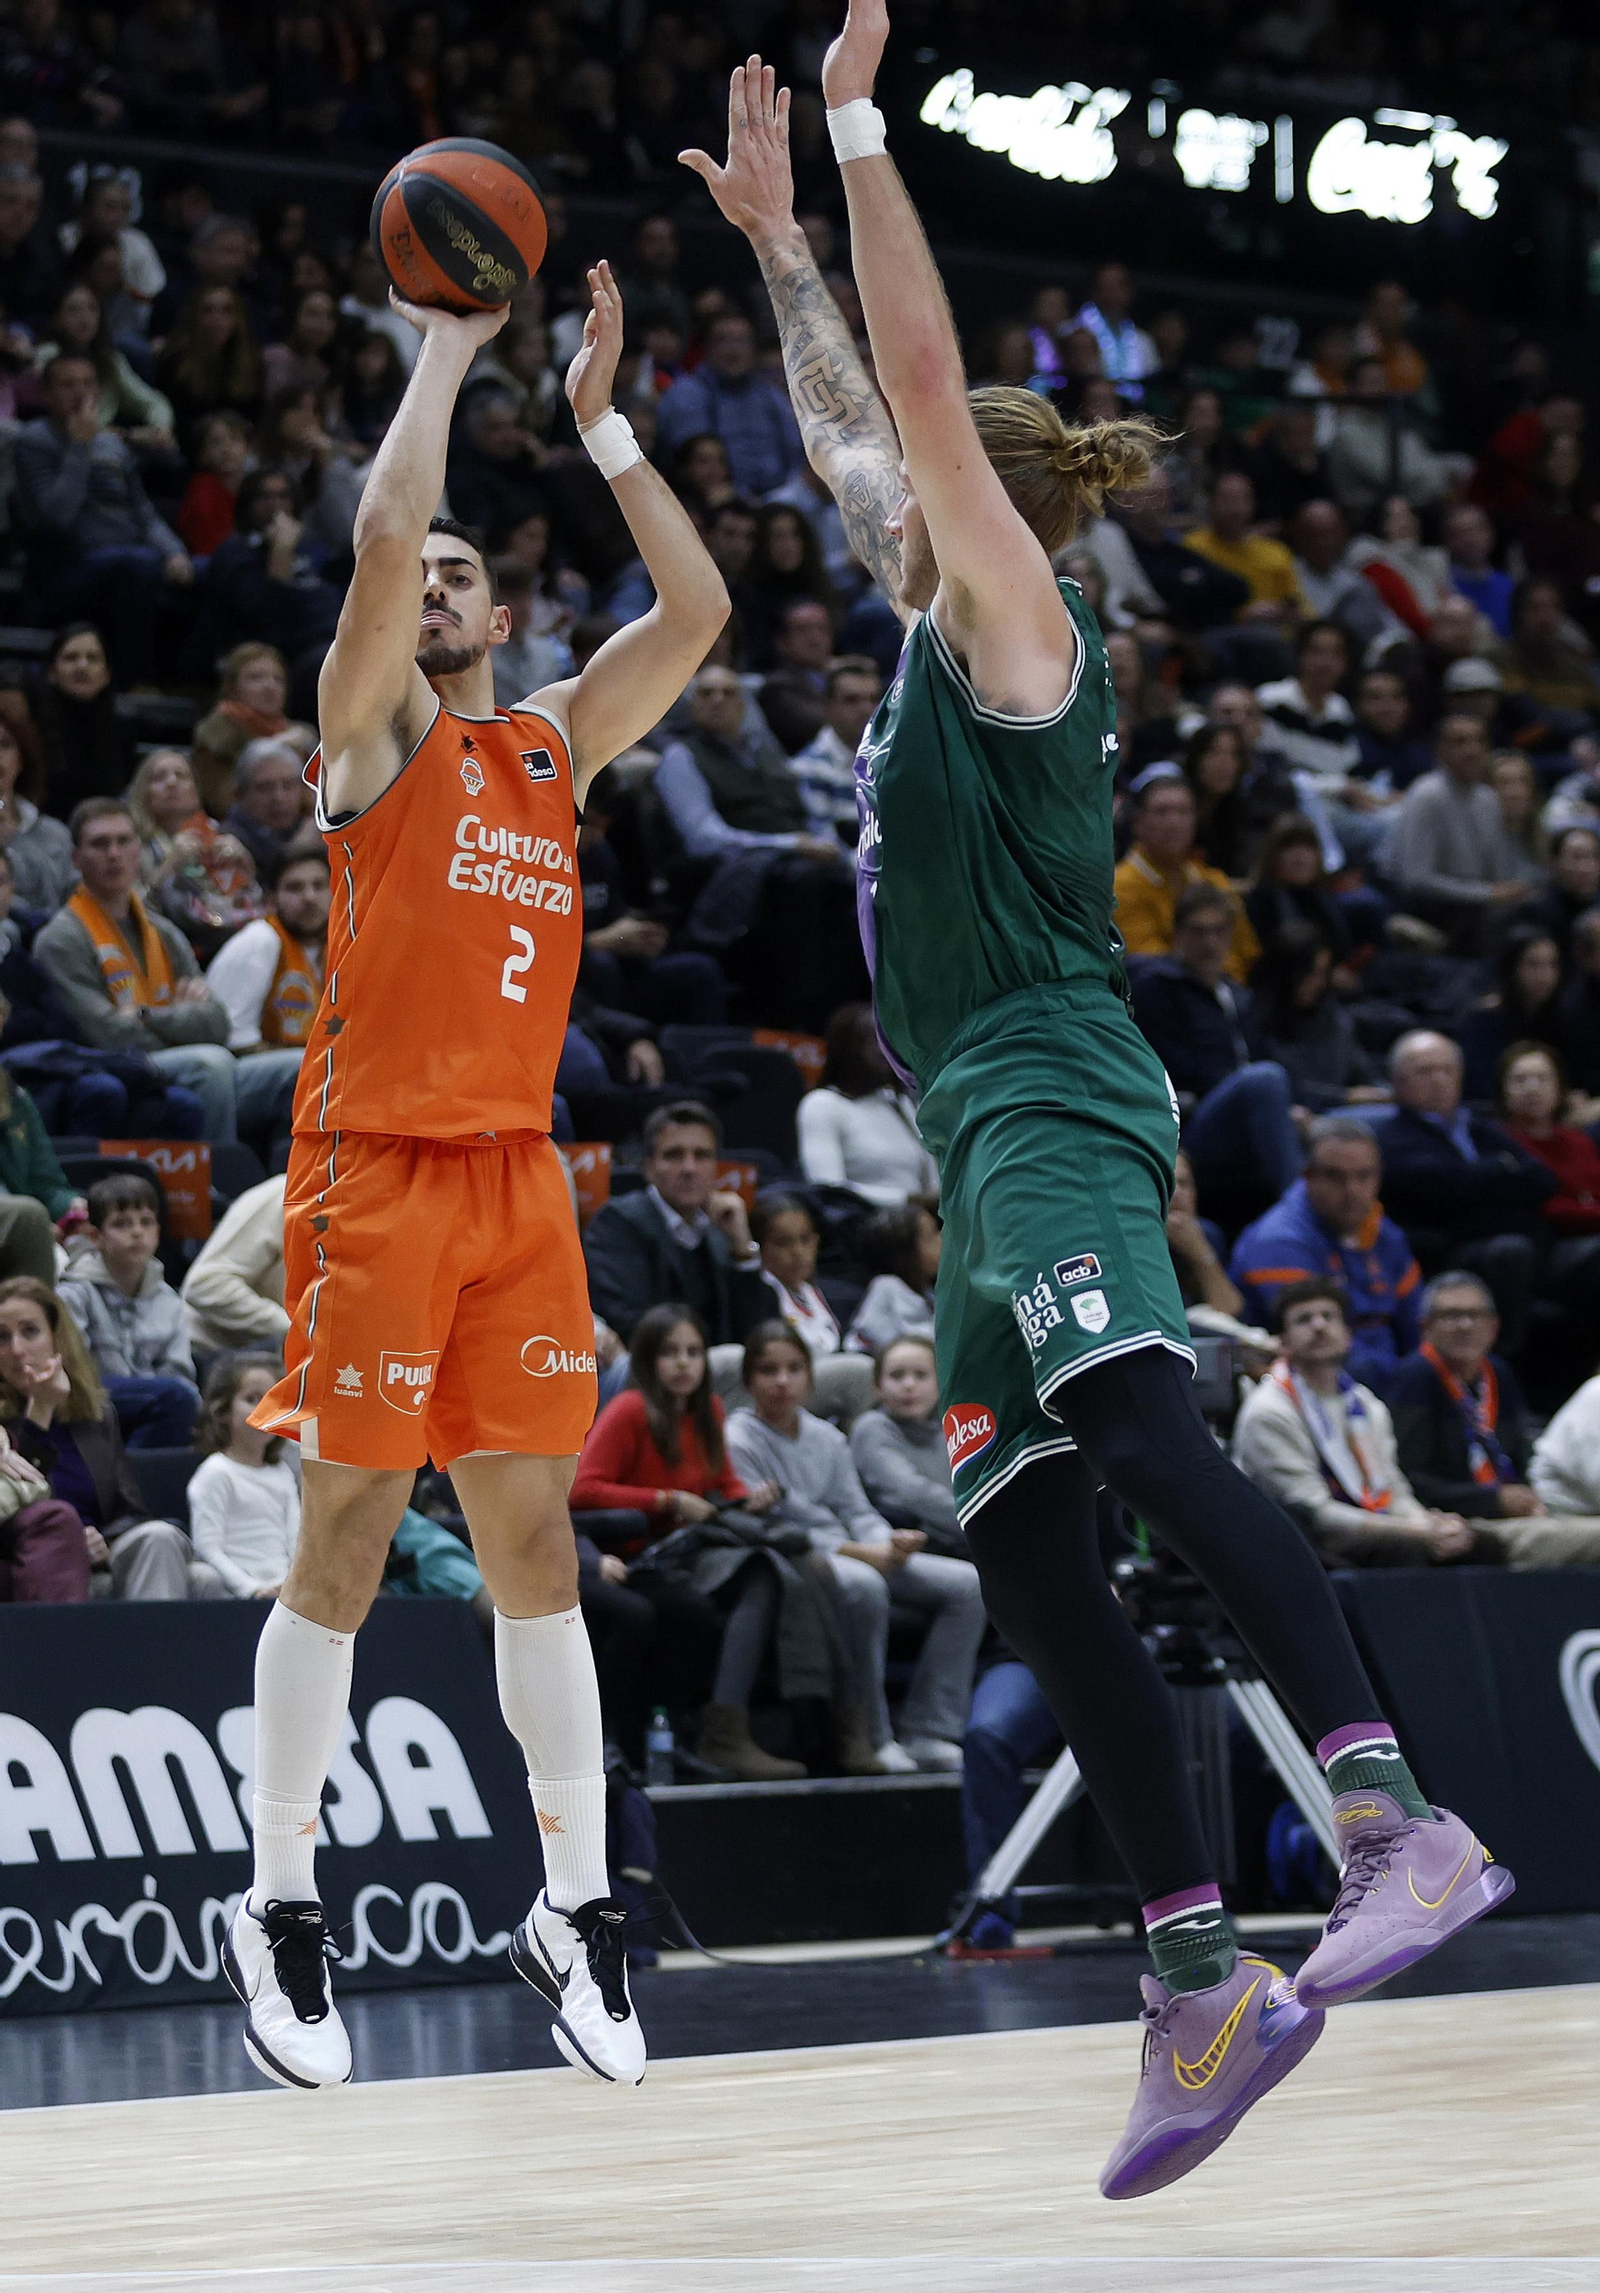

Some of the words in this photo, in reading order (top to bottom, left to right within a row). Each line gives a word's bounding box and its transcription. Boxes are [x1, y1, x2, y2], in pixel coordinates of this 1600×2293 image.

[528, 767, 554, 778] ndesa
[448, 852, 573, 916] Esfuerzo
[501, 924, 536, 1004] 2
[1061, 1265, 1091, 1283] acb
